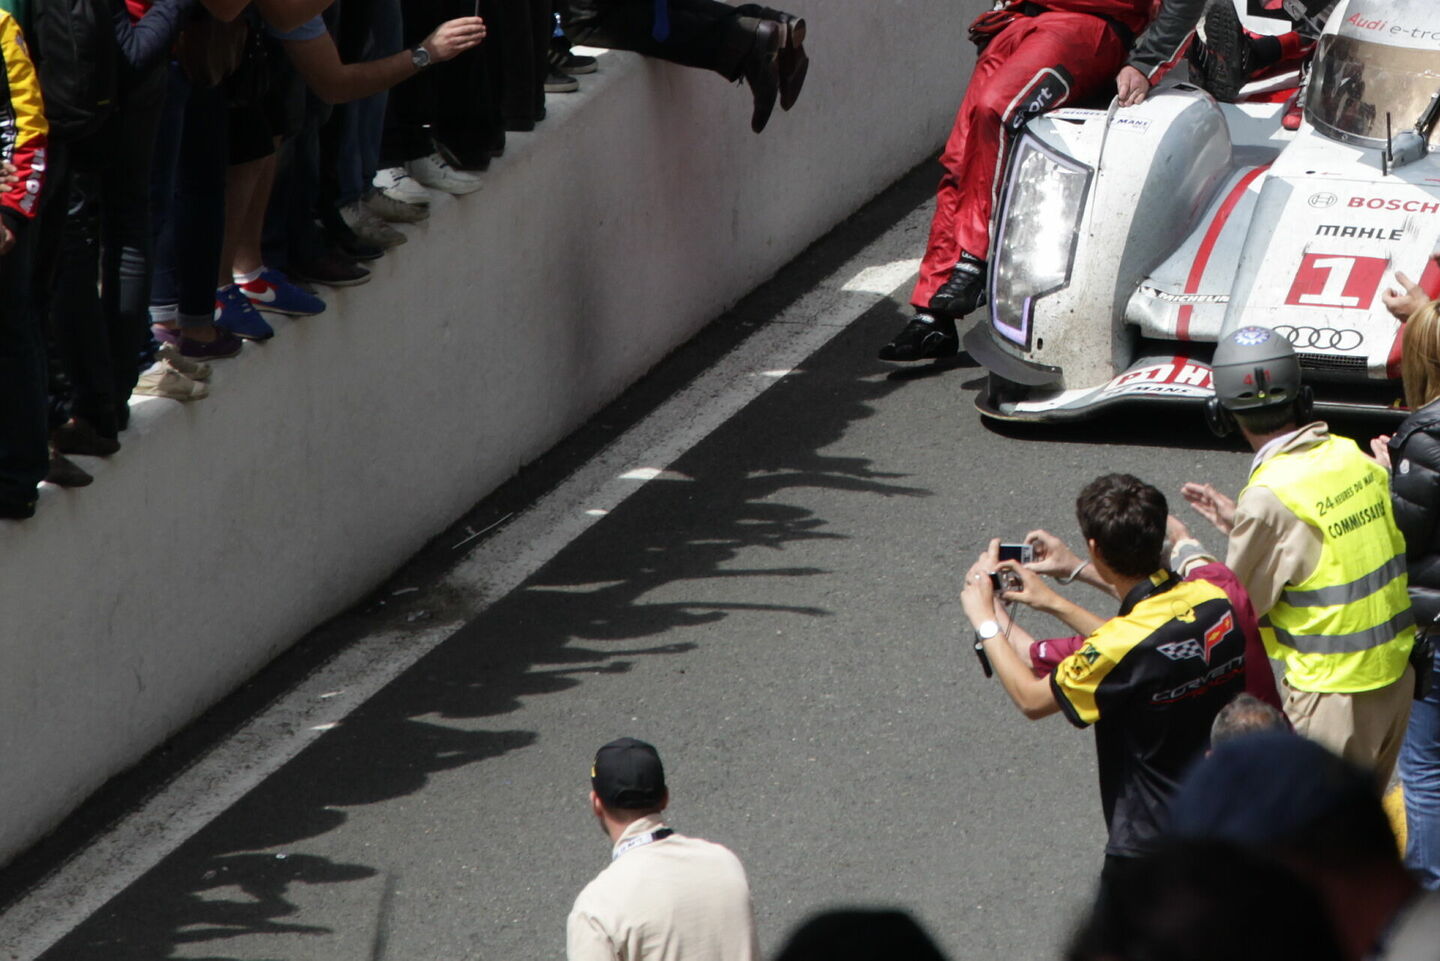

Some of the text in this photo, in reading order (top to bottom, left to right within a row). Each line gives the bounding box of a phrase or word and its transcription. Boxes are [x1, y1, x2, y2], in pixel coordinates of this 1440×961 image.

[1347, 12, 1388, 31] Audi
[1347, 196, 1440, 214] BOSCH
[1315, 224, 1405, 241] MAHLE
[1298, 257, 1361, 307] 1
[1316, 496, 1335, 517] 24
[1151, 654, 1245, 702] CORVETT
